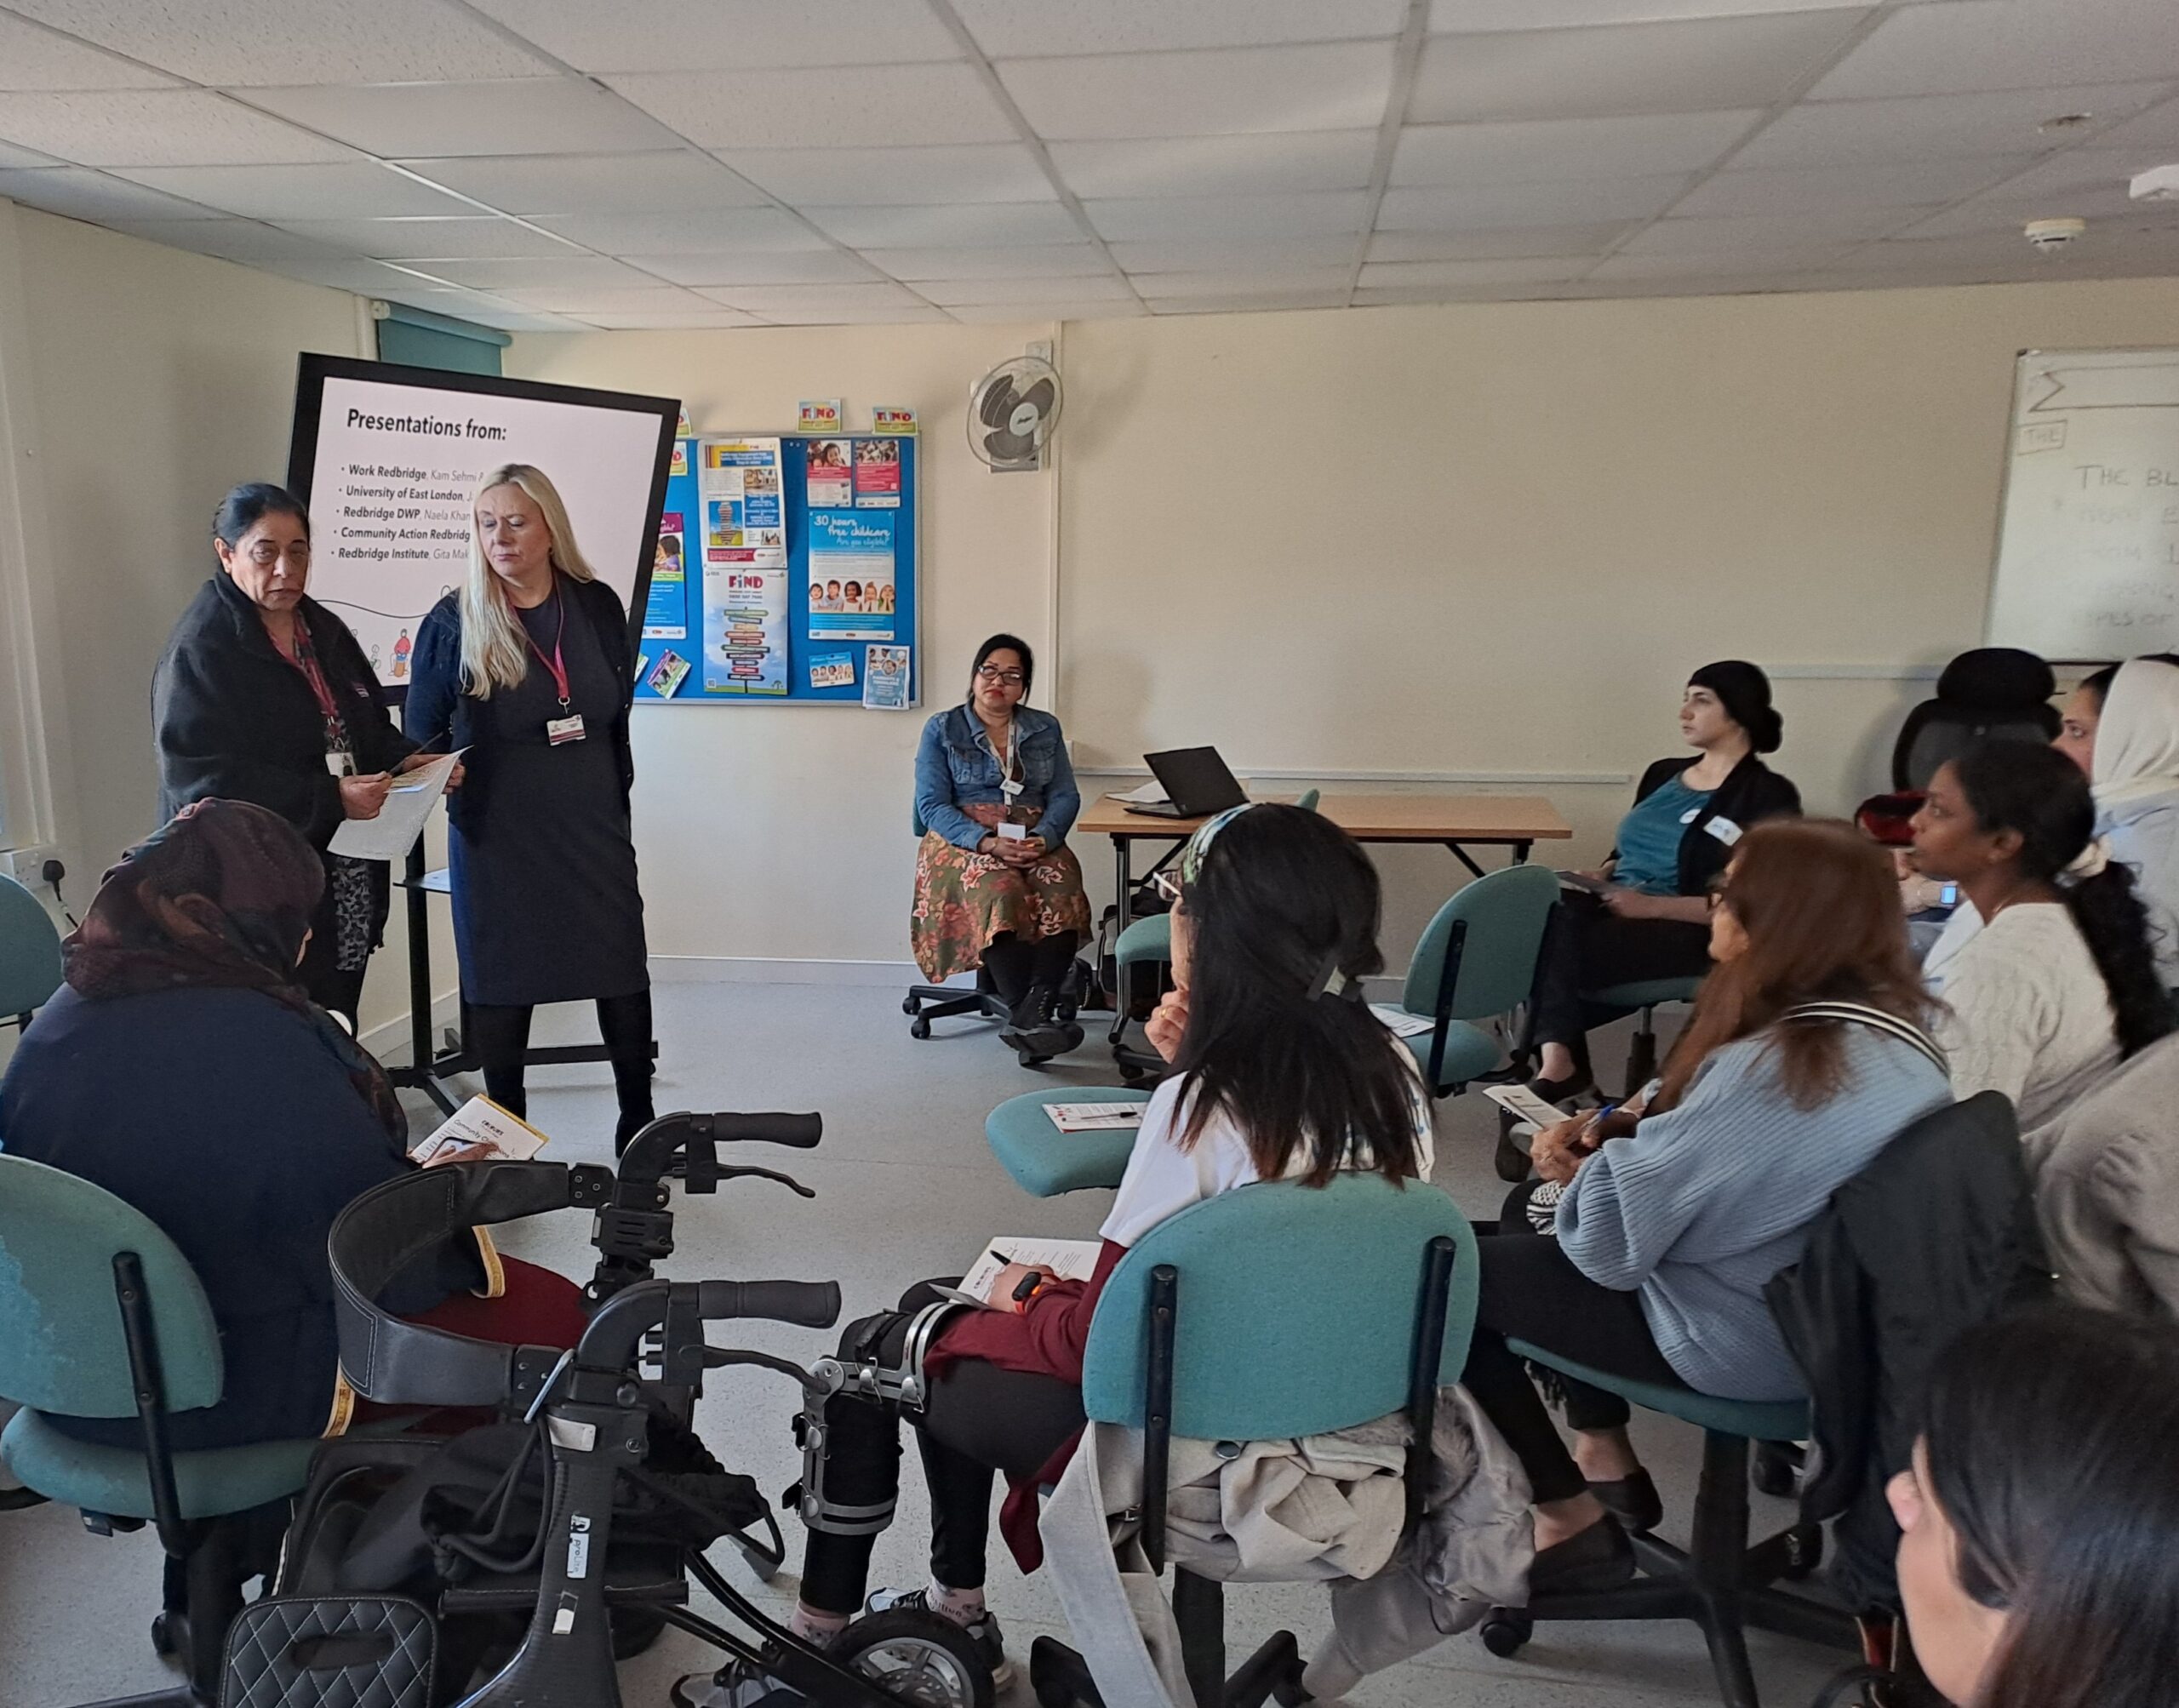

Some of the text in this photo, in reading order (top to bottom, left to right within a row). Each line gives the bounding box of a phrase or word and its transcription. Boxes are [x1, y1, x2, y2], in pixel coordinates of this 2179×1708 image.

[346, 408, 507, 440] Presentations from:
[348, 464, 375, 477] Work
[431, 469, 449, 481] Kam
[451, 470, 477, 482] Sehmi
[2073, 465, 2129, 489] THE
[346, 485, 396, 501] University
[397, 487, 409, 499] of
[409, 488, 428, 500] East
[343, 506, 394, 522] Redbridge
[424, 510, 449, 521] Naela
[814, 515, 857, 527] 30 hours
[340, 526, 471, 543] Community Action Redbridg
[827, 524, 891, 537] free childcare
[338, 547, 390, 562] Redbridge
[432, 548, 451, 560] Gita
[729, 574, 764, 589] FiND
[454, 1119, 481, 1141] Community
